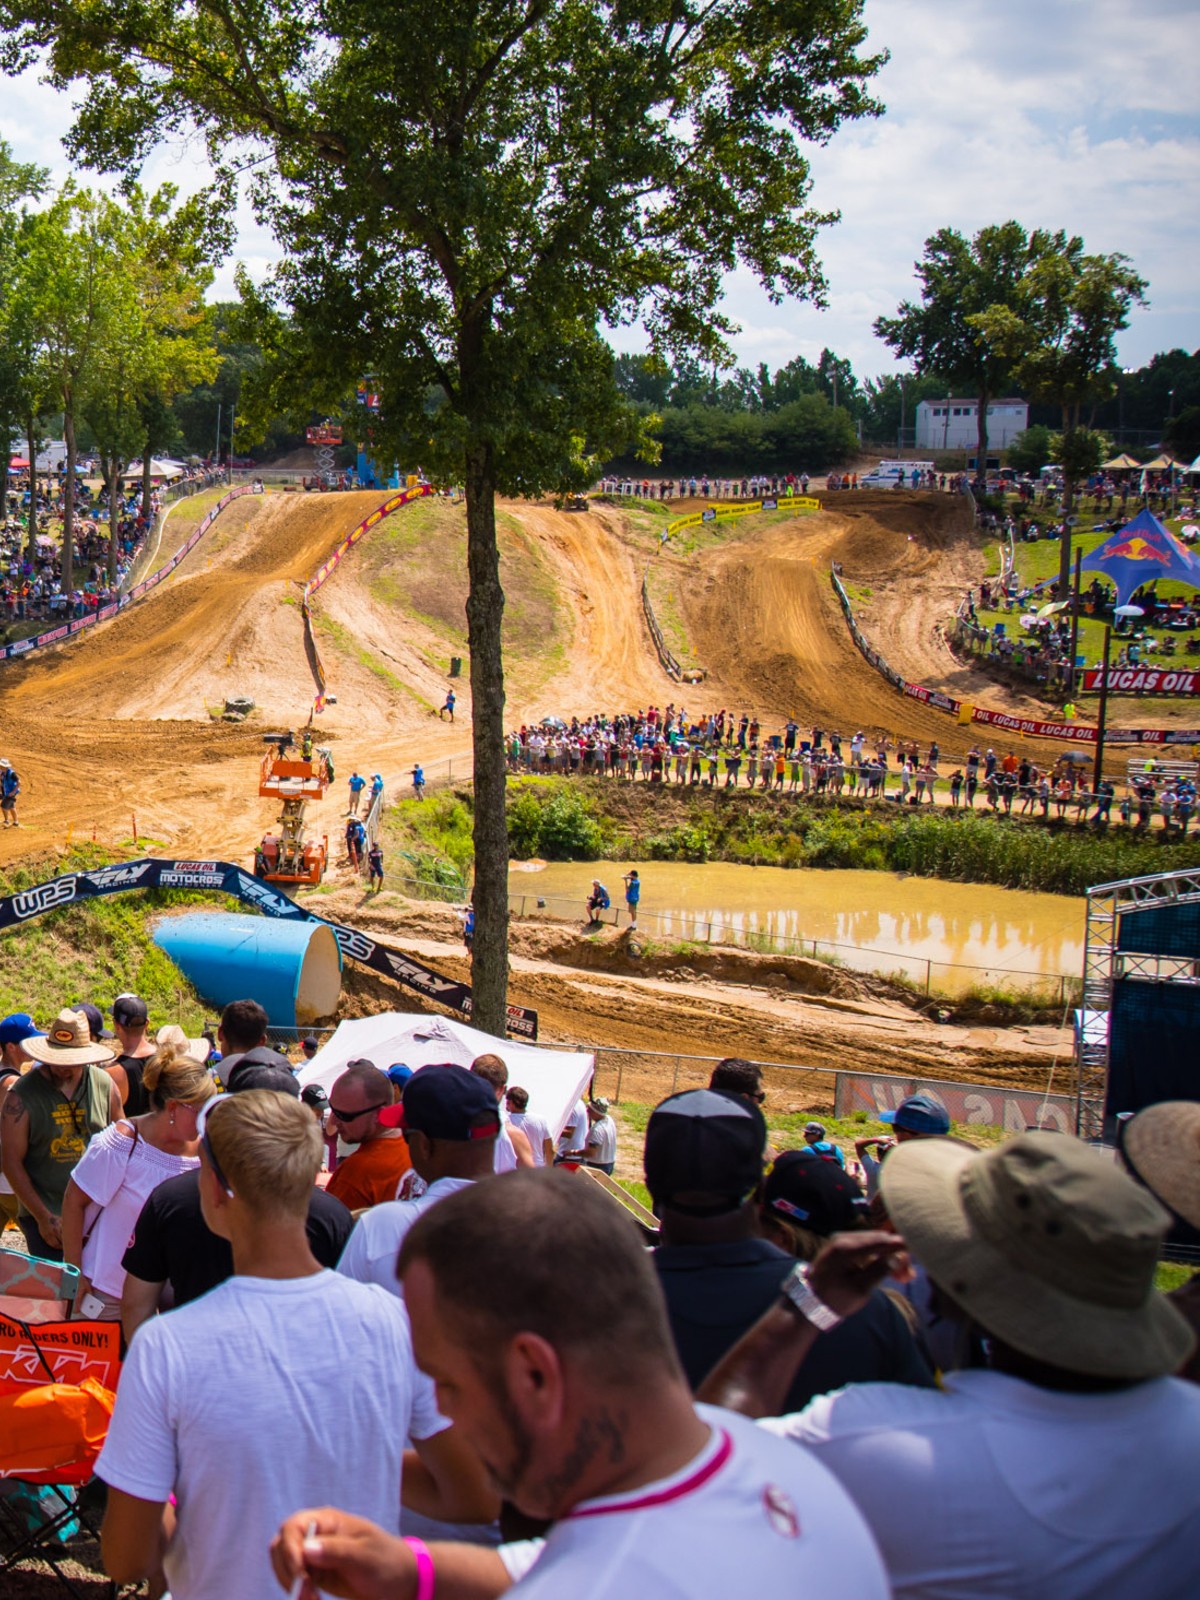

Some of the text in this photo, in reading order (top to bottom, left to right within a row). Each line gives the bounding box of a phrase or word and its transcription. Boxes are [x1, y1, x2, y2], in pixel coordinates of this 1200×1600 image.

[1092, 671, 1194, 691] LUCAS OIL
[992, 714, 1020, 728] LUCAS
[1022, 721, 1036, 732] OIL
[1040, 724, 1073, 737] LUCAS
[1076, 728, 1094, 739] OIL
[1142, 732, 1160, 740] OIL
[85, 864, 152, 886] FLY
[12, 877, 77, 918] WPS
[237, 872, 300, 914] FLY
[384, 952, 458, 992] FLY
[508, 1008, 522, 1017] OIL
[19, 1330, 68, 1344] RDERS
[72, 1331, 109, 1348] ONLY!
